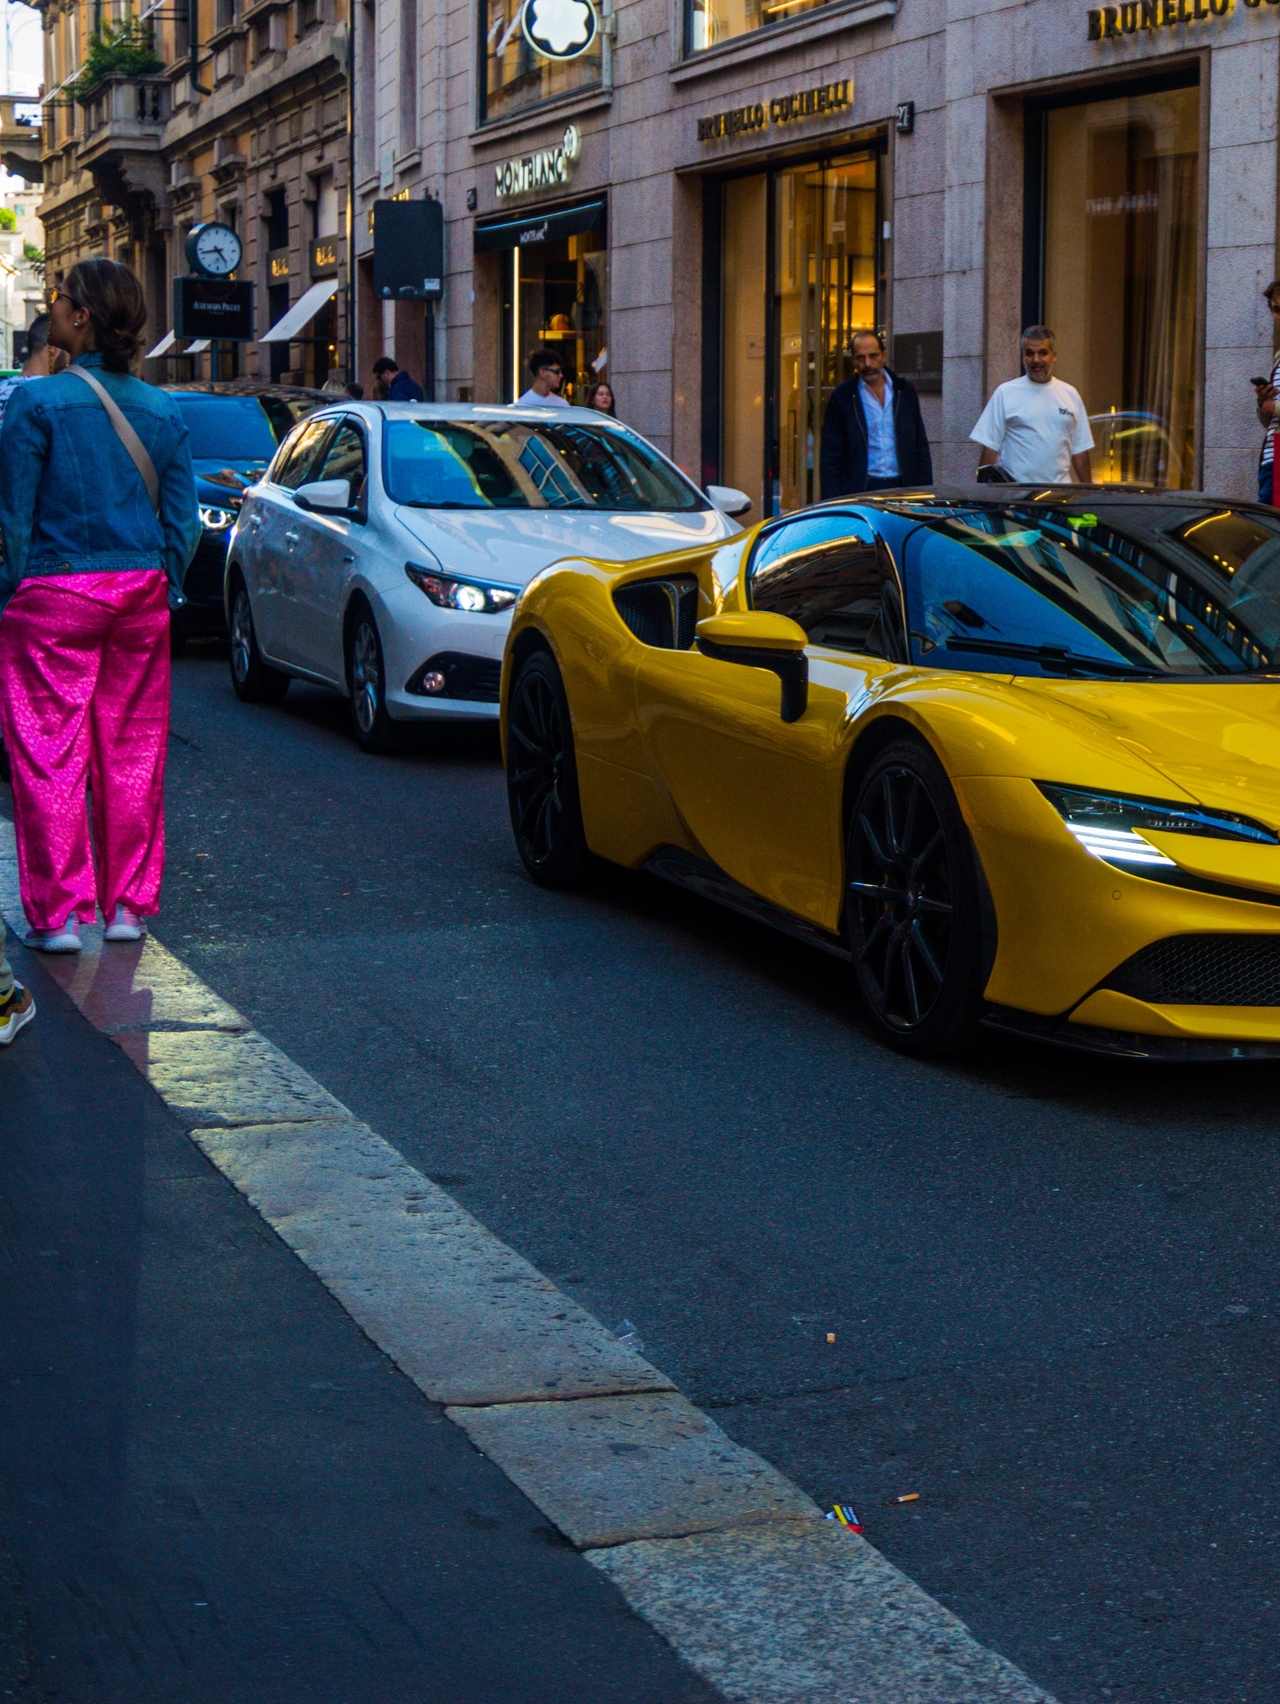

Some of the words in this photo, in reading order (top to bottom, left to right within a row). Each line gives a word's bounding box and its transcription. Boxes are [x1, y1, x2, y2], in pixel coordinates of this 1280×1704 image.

[1087, 0, 1228, 41] BRUNELLO
[697, 103, 764, 141] BRUNELLO
[769, 79, 852, 123] CUCINELLI
[495, 149, 568, 197] MONTBLANC
